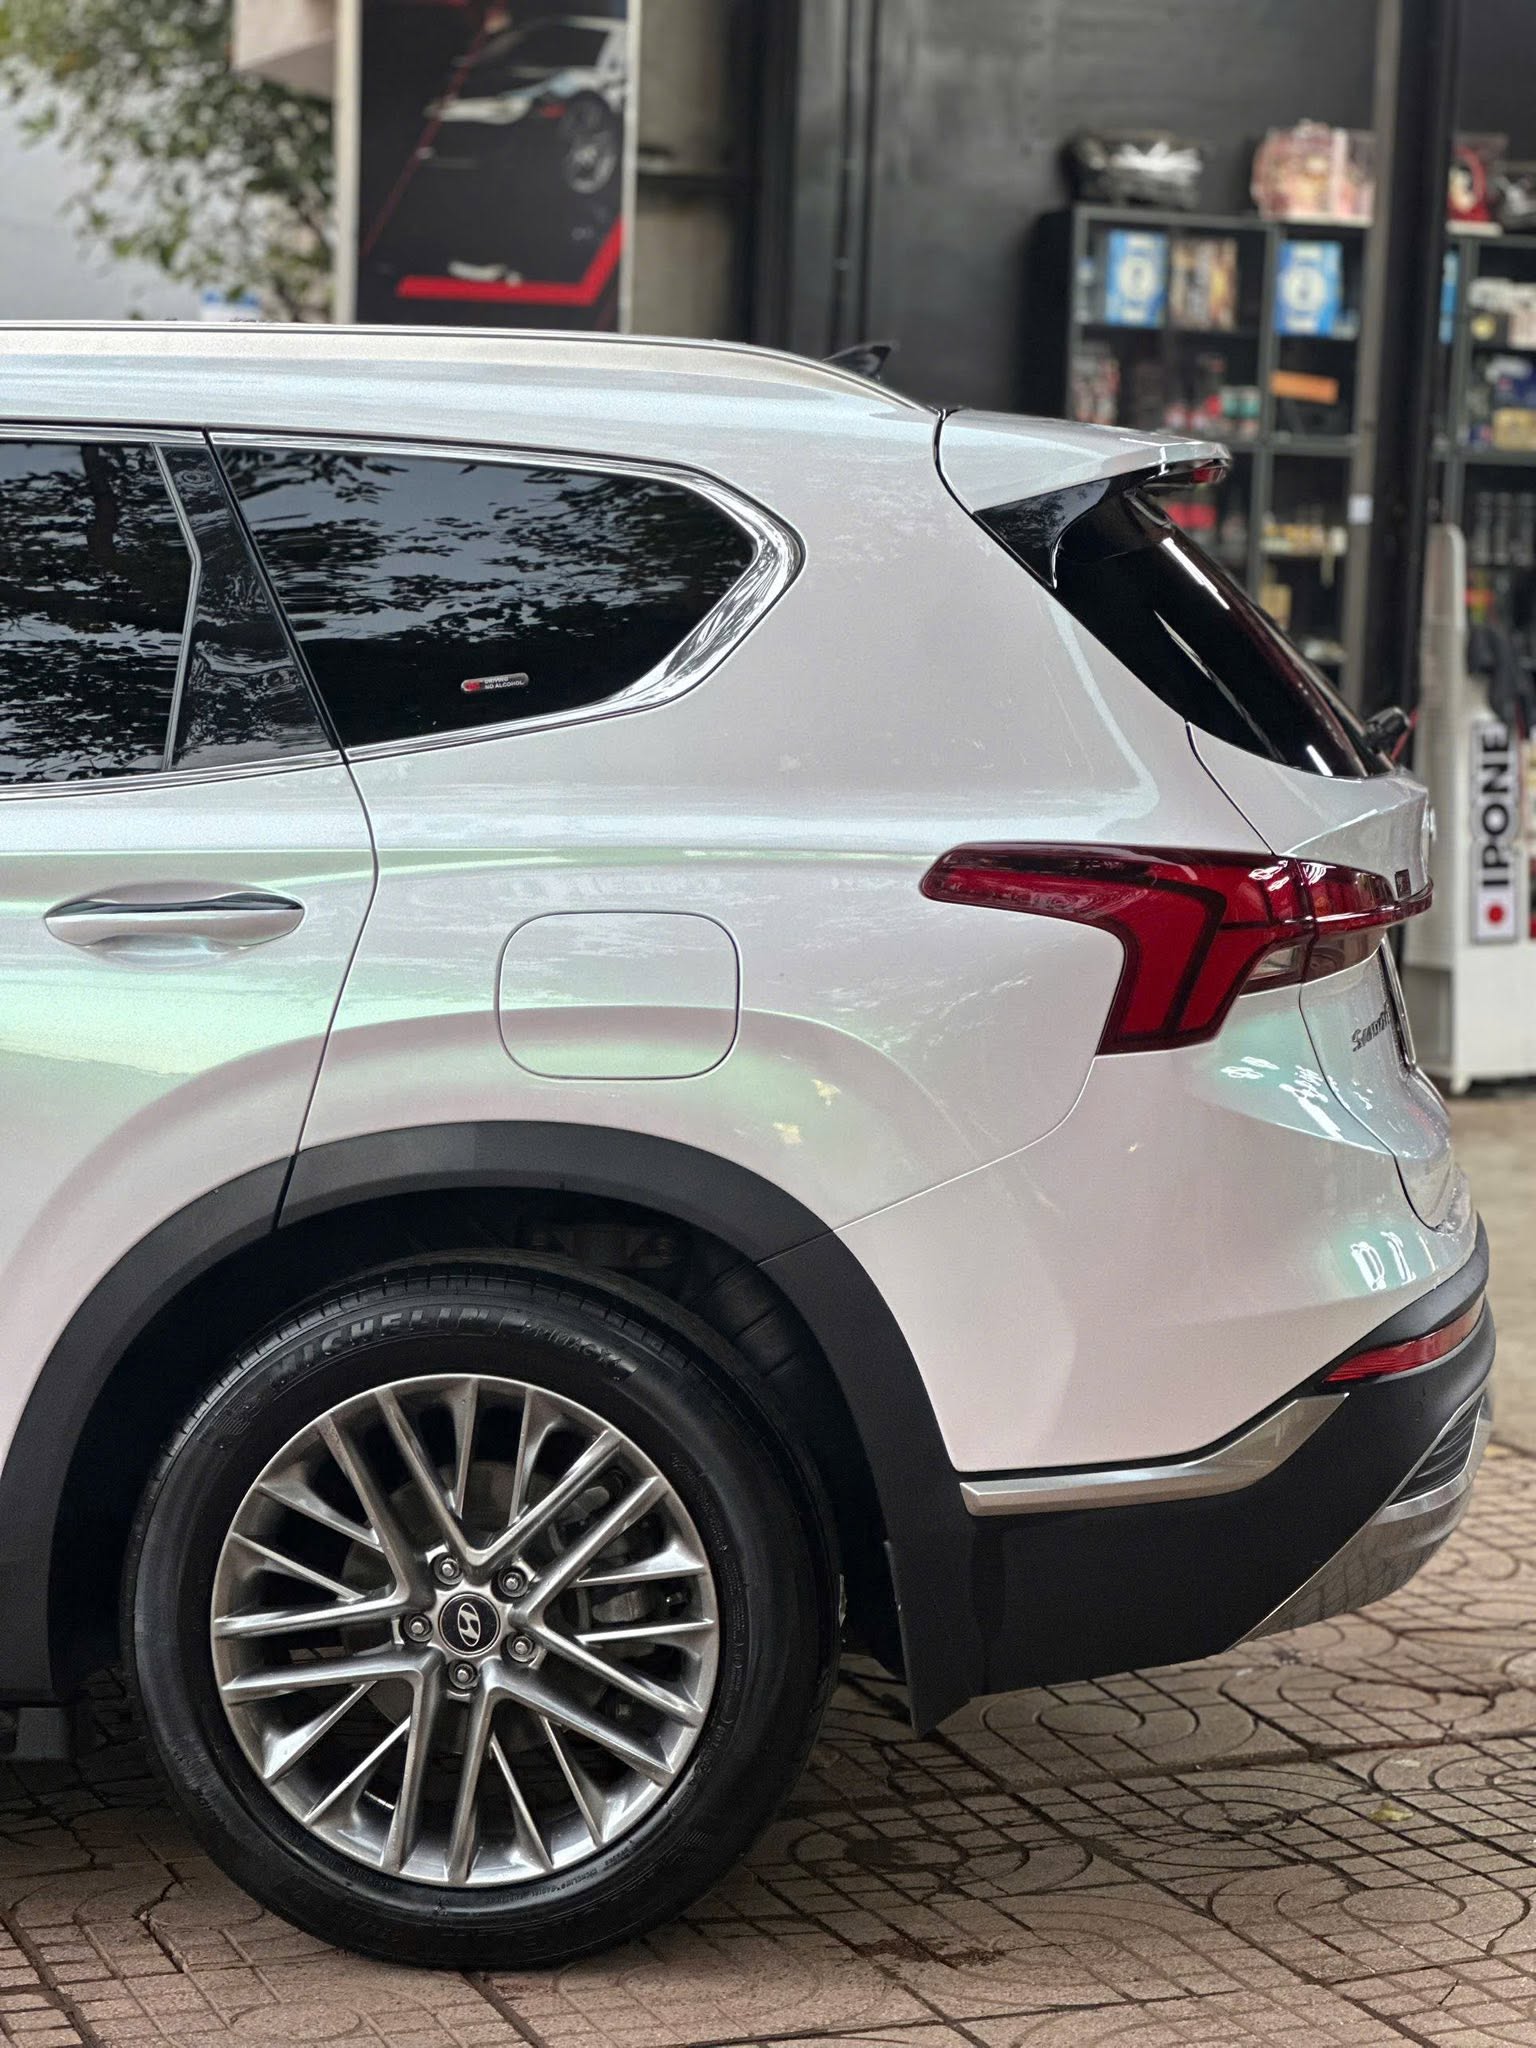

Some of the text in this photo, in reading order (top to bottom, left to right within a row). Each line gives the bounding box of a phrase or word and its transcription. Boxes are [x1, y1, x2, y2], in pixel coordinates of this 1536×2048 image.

[495, 680, 524, 689] ALCOHOL
[1482, 729, 1510, 887] IPONE
[269, 1306, 491, 1386] MICHELIN
